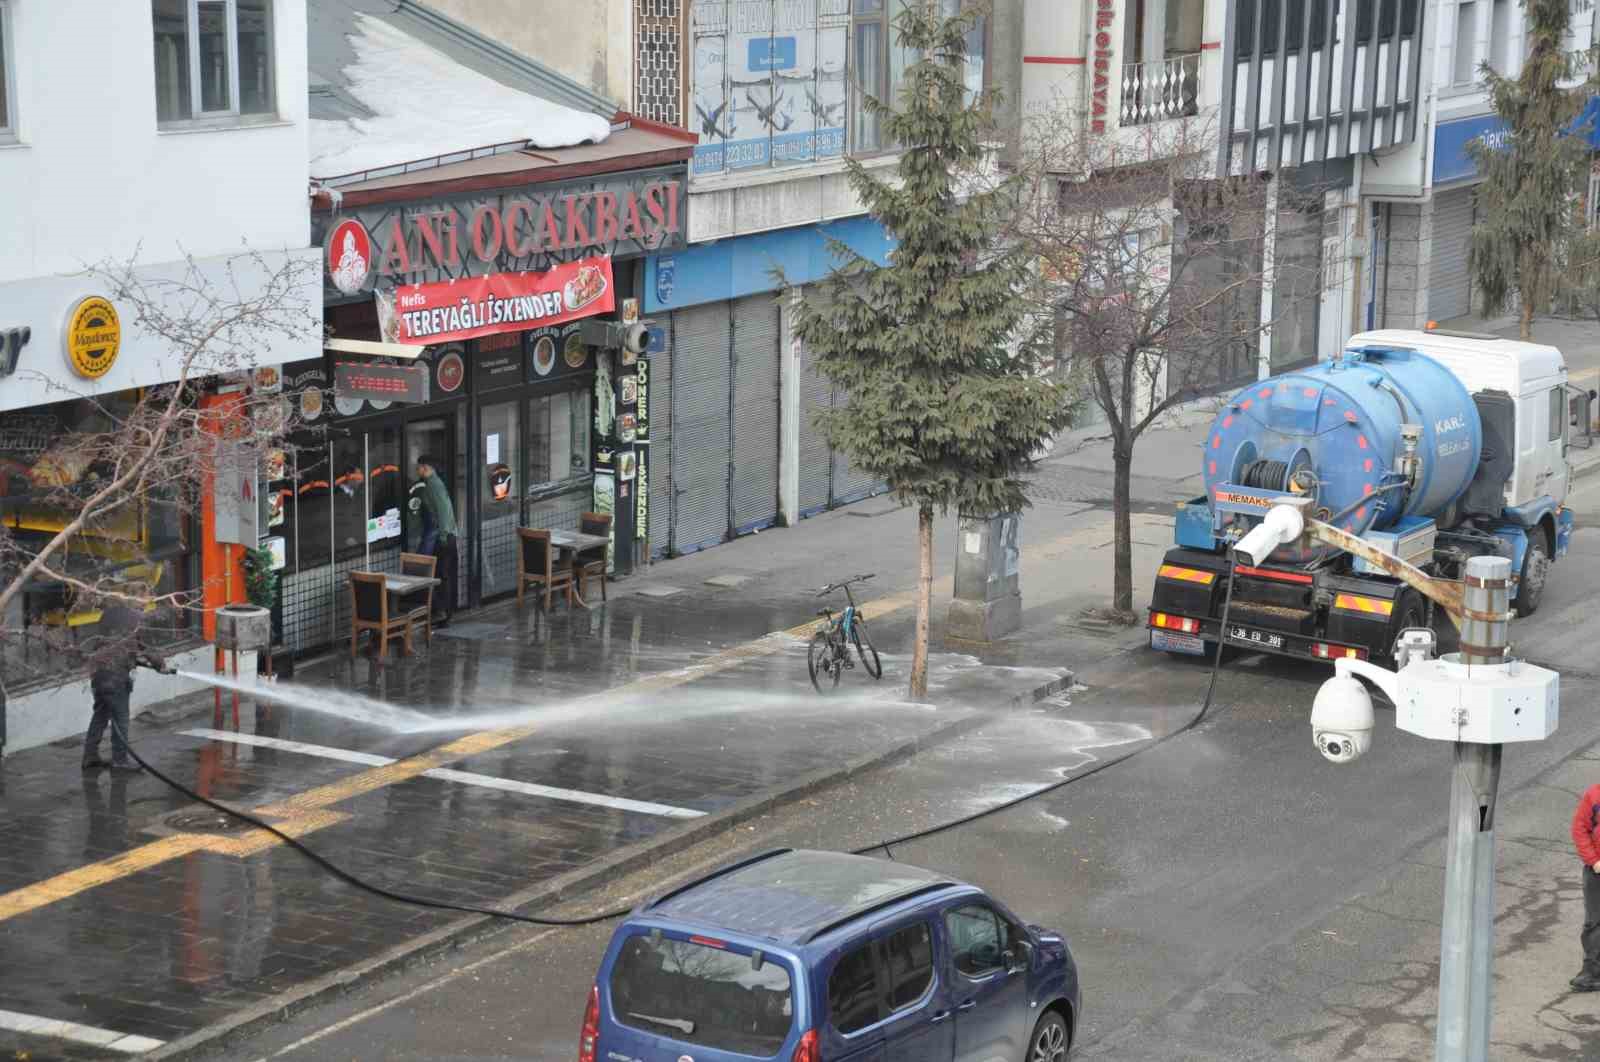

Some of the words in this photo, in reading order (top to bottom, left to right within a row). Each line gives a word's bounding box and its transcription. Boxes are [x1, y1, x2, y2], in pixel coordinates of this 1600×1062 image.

[472, 181, 680, 262] OCAKBAŞI
[401, 293, 426, 307] Nefis
[403, 297, 485, 338] TEREYAĞLI
[487, 291, 562, 326] İSKENDER
